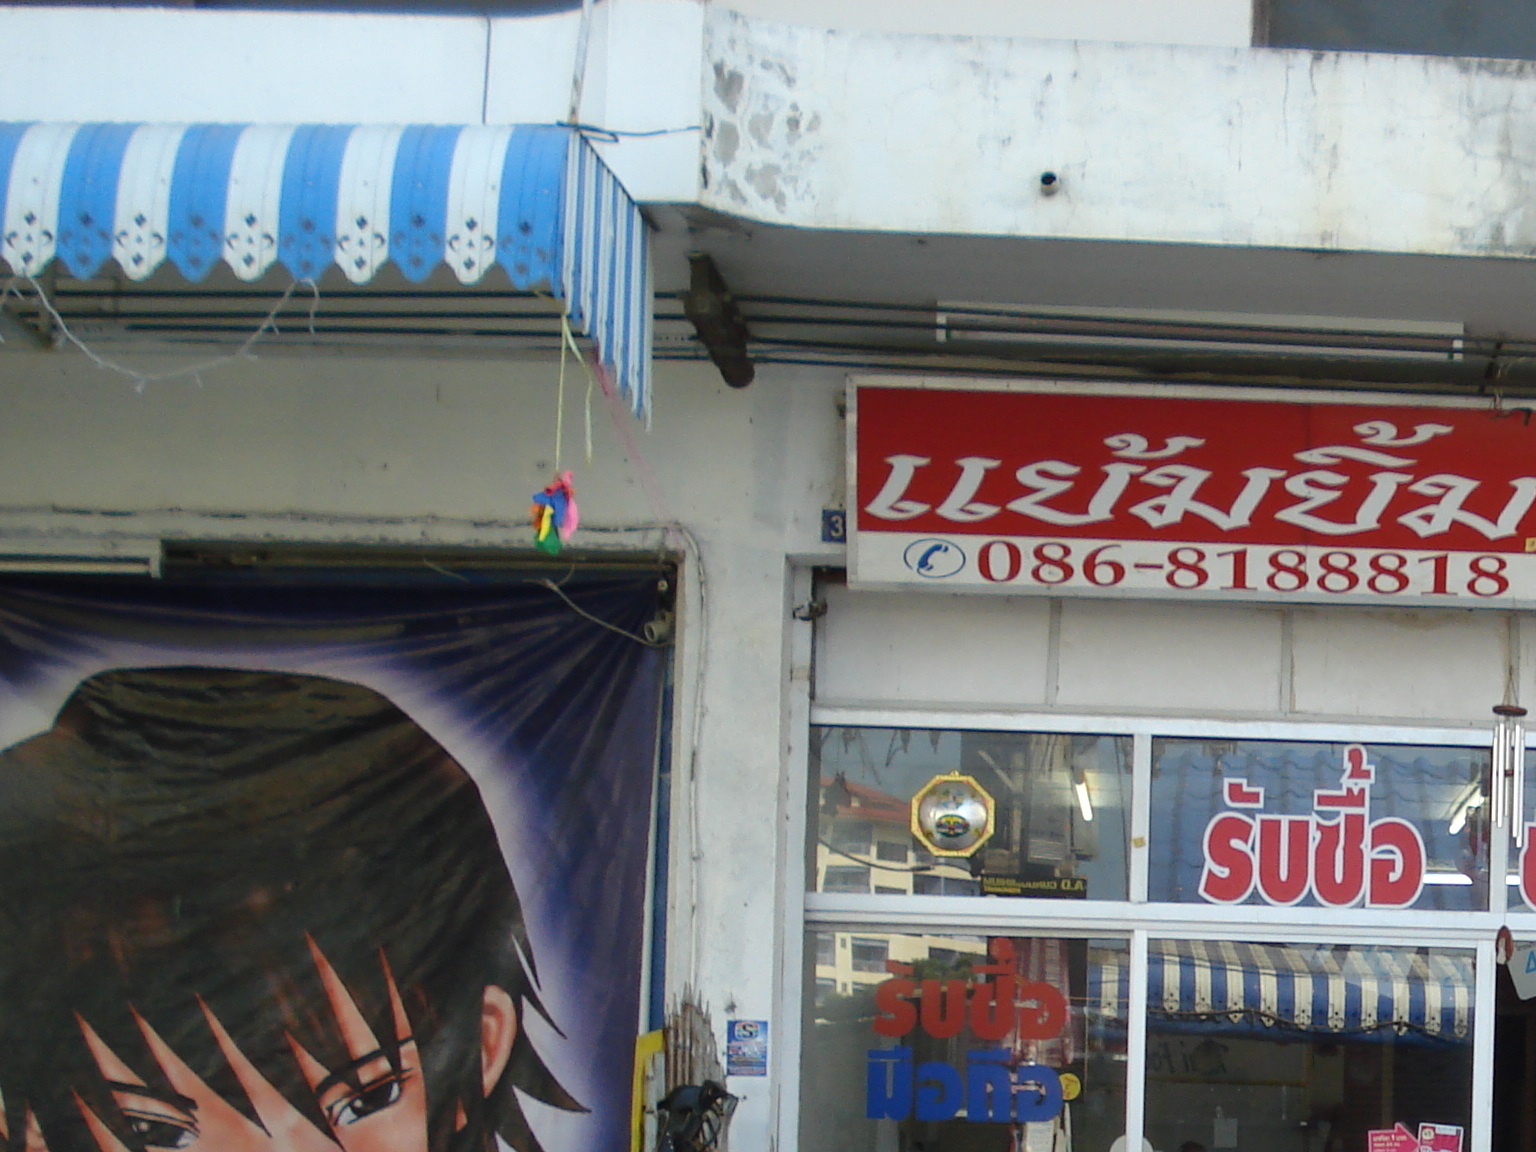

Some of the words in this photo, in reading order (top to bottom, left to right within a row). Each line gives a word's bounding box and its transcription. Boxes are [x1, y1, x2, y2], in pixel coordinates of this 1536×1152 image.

[977, 540, 1510, 598] 086-8188818
[1198, 744, 1427, 908] รับซื้อ
[872, 937, 1067, 1040] รับซื้อ
[866, 1045, 1064, 1124] มือถือ
